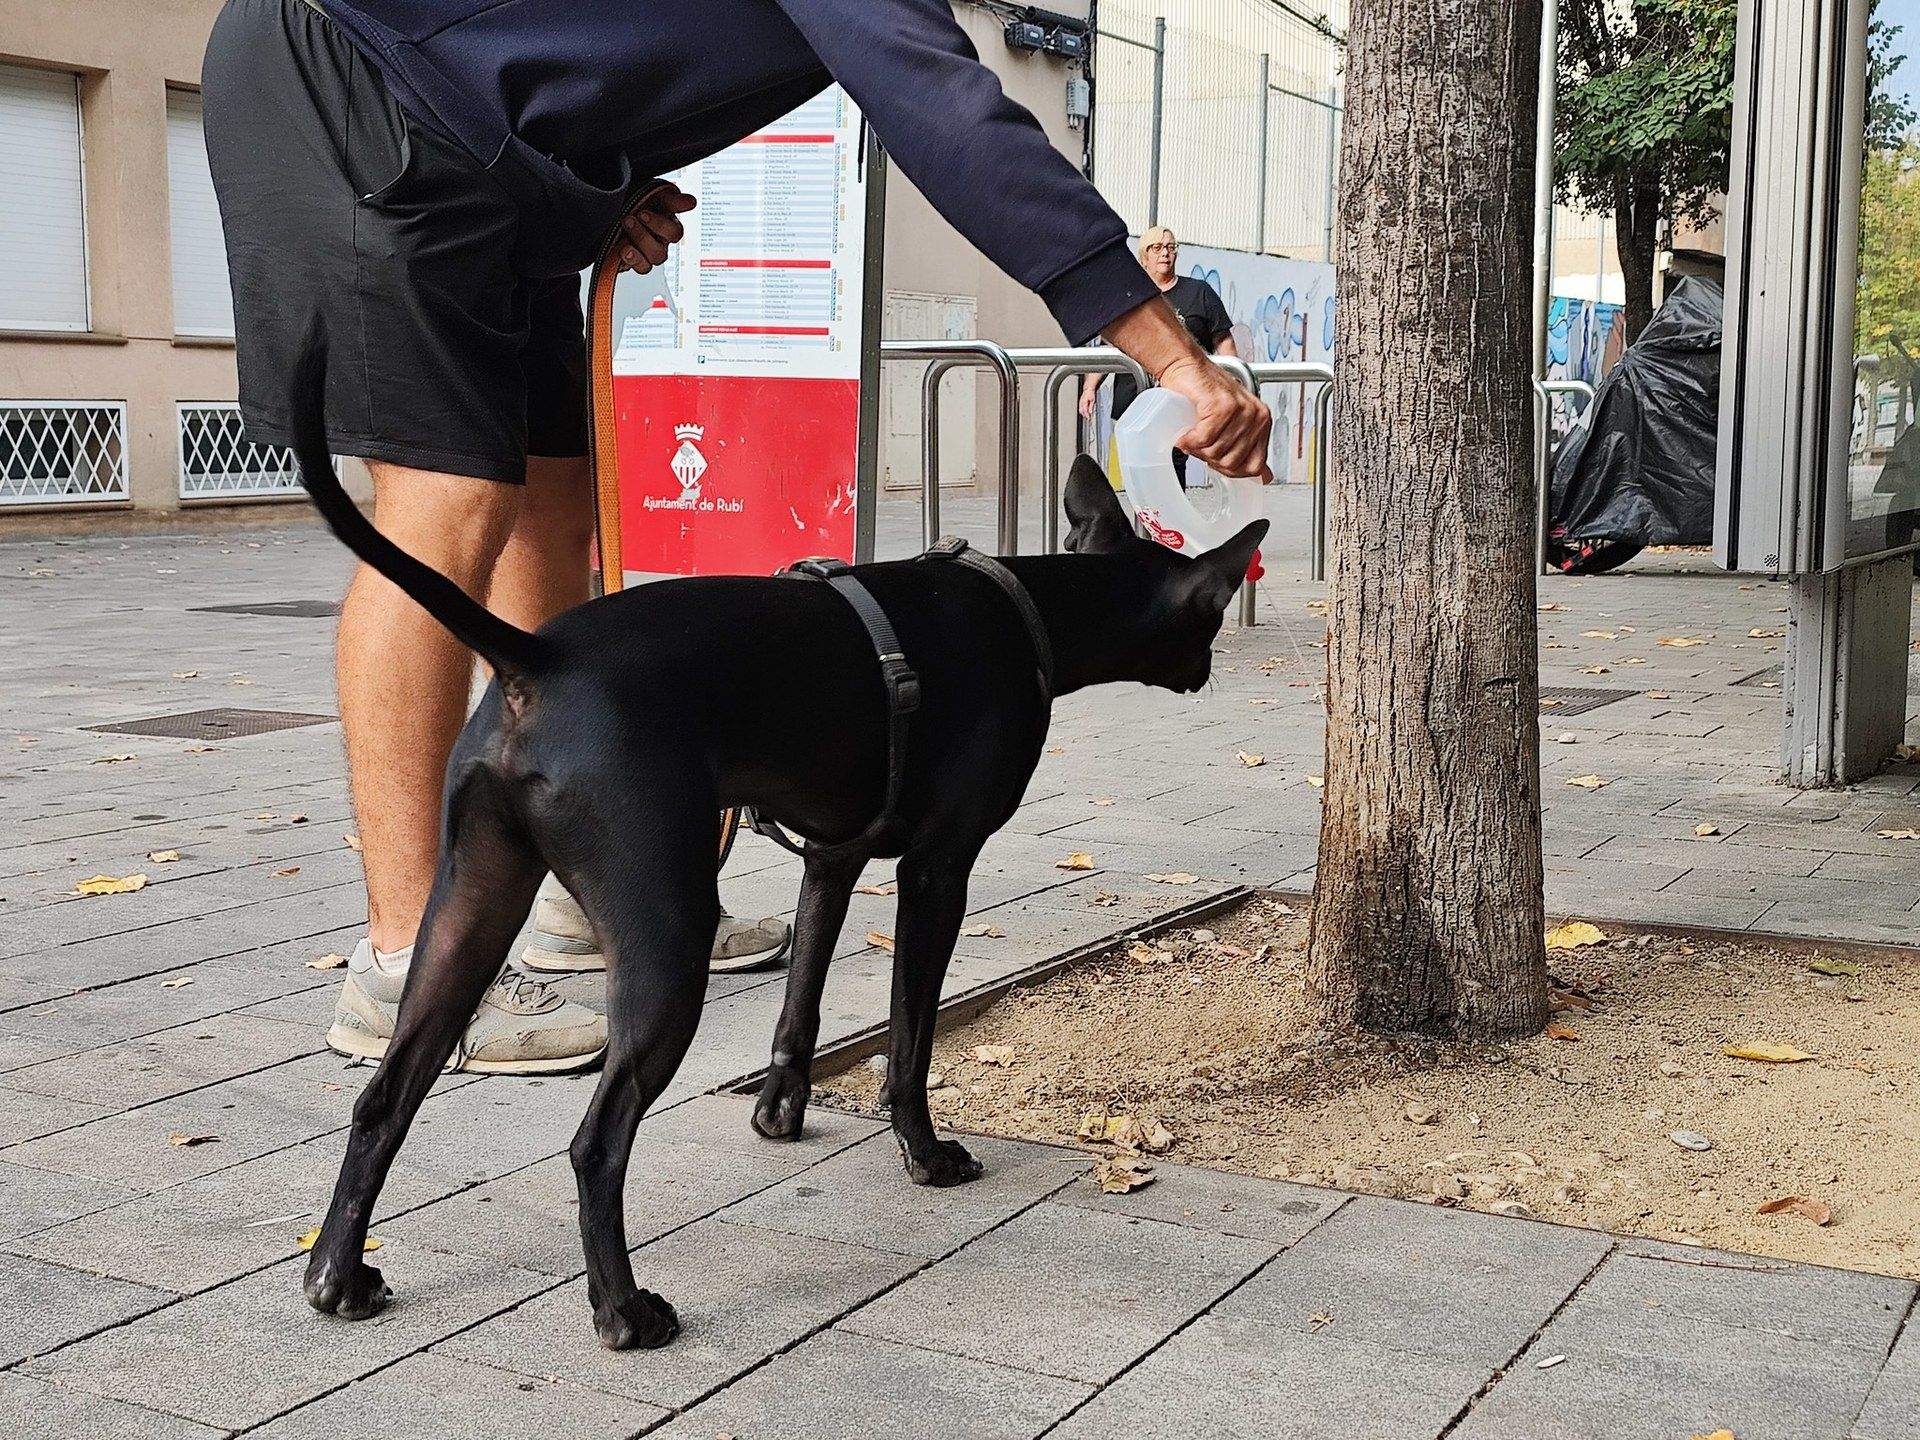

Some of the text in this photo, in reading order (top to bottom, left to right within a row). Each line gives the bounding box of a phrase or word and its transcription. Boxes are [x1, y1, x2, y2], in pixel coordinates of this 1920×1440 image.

[642, 495, 744, 512] Ajuntament de Rubí
